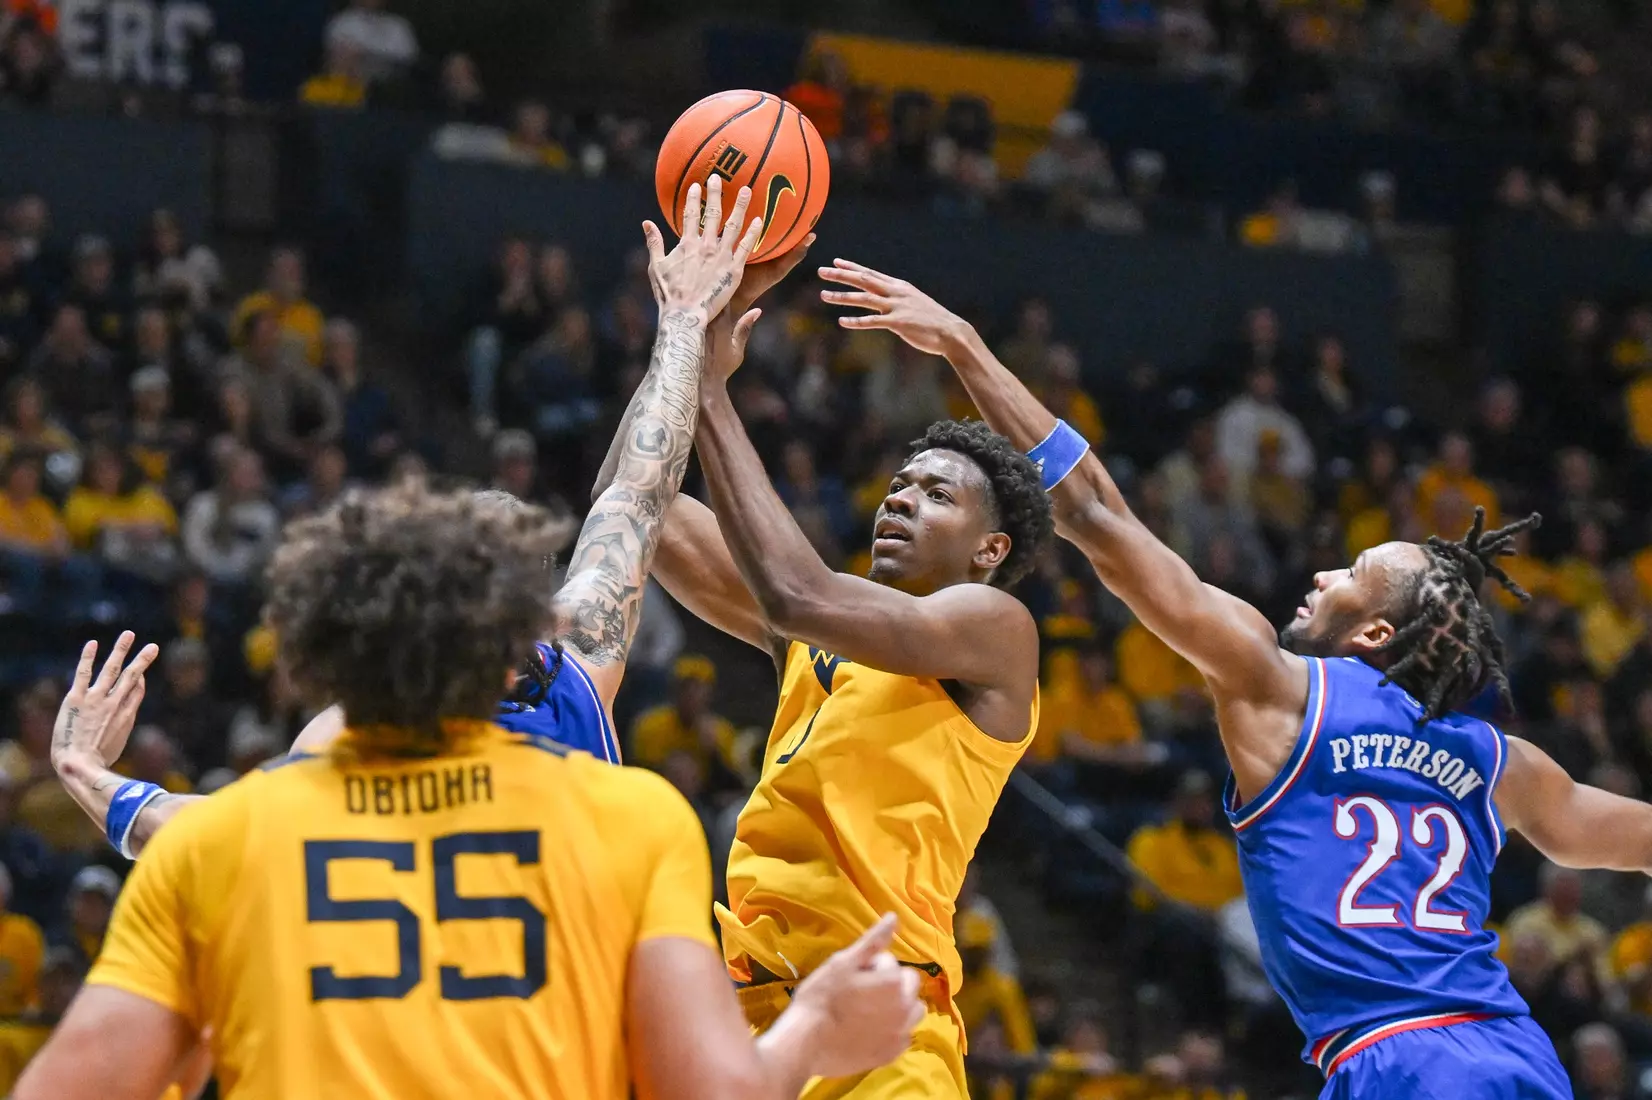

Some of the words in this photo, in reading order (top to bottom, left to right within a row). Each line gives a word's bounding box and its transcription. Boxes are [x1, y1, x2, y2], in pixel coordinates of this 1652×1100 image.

[345, 763, 494, 816] OBIOHA
[1329, 733, 1485, 800] PETERSON
[303, 829, 548, 1003] 55
[1332, 792, 1473, 936] 22
